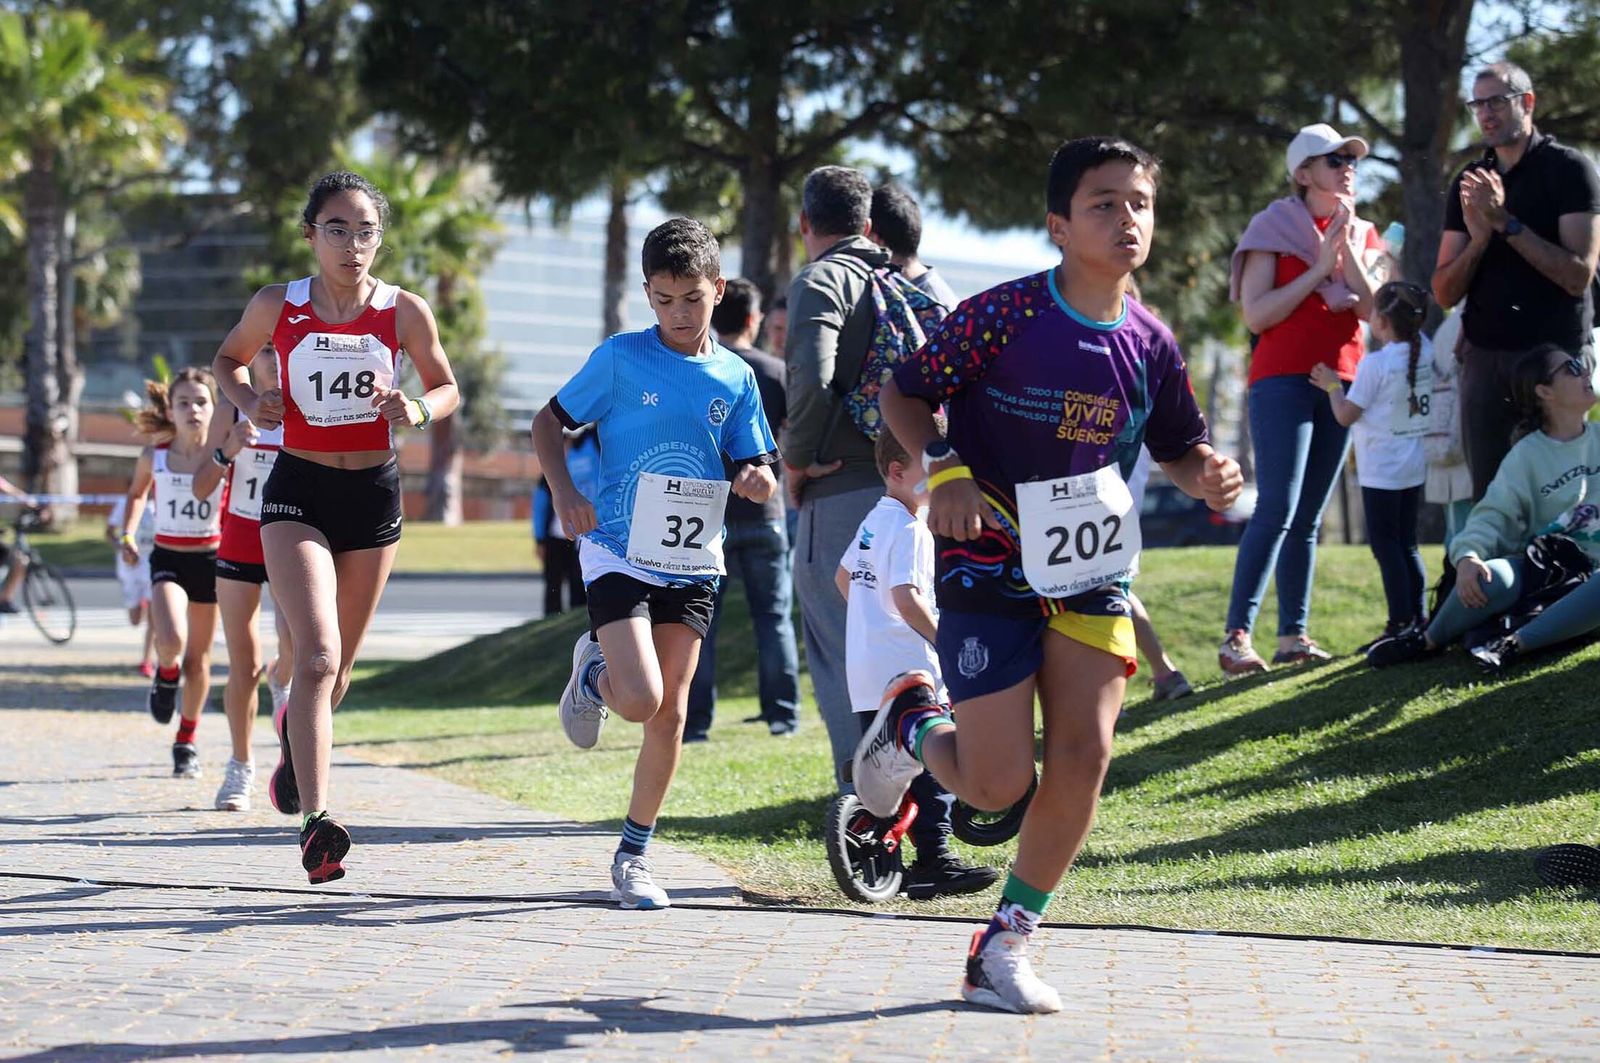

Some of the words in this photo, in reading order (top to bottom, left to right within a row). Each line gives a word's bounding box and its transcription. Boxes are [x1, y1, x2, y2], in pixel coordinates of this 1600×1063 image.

[308, 371, 376, 401] 148
[1064, 390, 1120, 410] CONSIGUE
[343, 413, 354, 421] tus
[1010, 407, 1047, 422] IMPULSO
[1049, 414, 1060, 423] DE
[1061, 417, 1077, 428] LOS
[1019, 398, 1049, 409] GANAS
[1051, 402, 1063, 411] DE
[1064, 401, 1115, 428] VIVIR
[629, 441, 706, 472] ONUBENSE
[167, 499, 211, 520] 140
[661, 515, 704, 549] 32
[1045, 514, 1122, 566] 202
[635, 556, 662, 568] Huelva
[1090, 576, 1104, 585] tus
